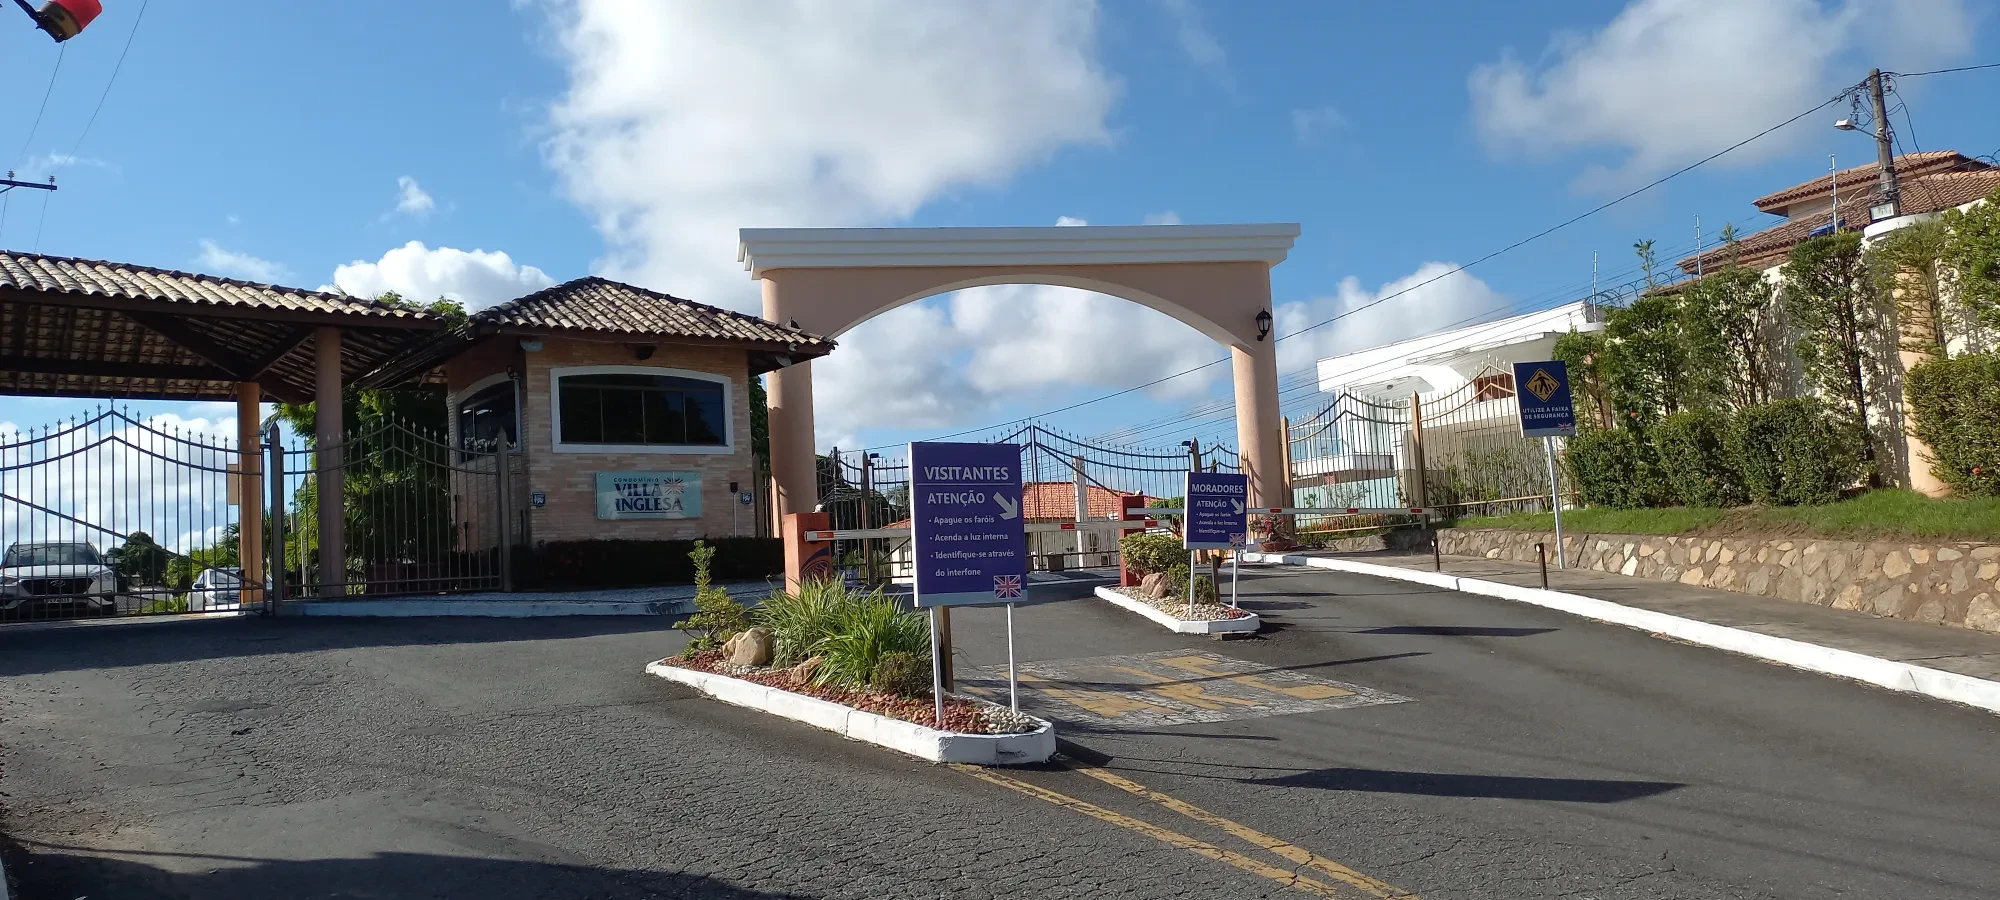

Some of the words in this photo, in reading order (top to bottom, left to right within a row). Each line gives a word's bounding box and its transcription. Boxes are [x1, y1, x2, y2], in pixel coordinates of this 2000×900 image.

[924, 466, 1009, 480] VISITANTES
[614, 484, 663, 496] VILLA
[1192, 484, 1244, 494] MORADORES
[928, 490, 986, 507] ATENÇÃO
[1196, 499, 1227, 508] ATENÇÃO
[615, 498, 684, 511] INGLESA
[934, 516, 962, 525] Apague
[974, 515, 994, 523] faróis
[935, 551, 986, 560] Identifique-se
[988, 549, 1014, 557] através
[947, 568, 981, 576] interfone
